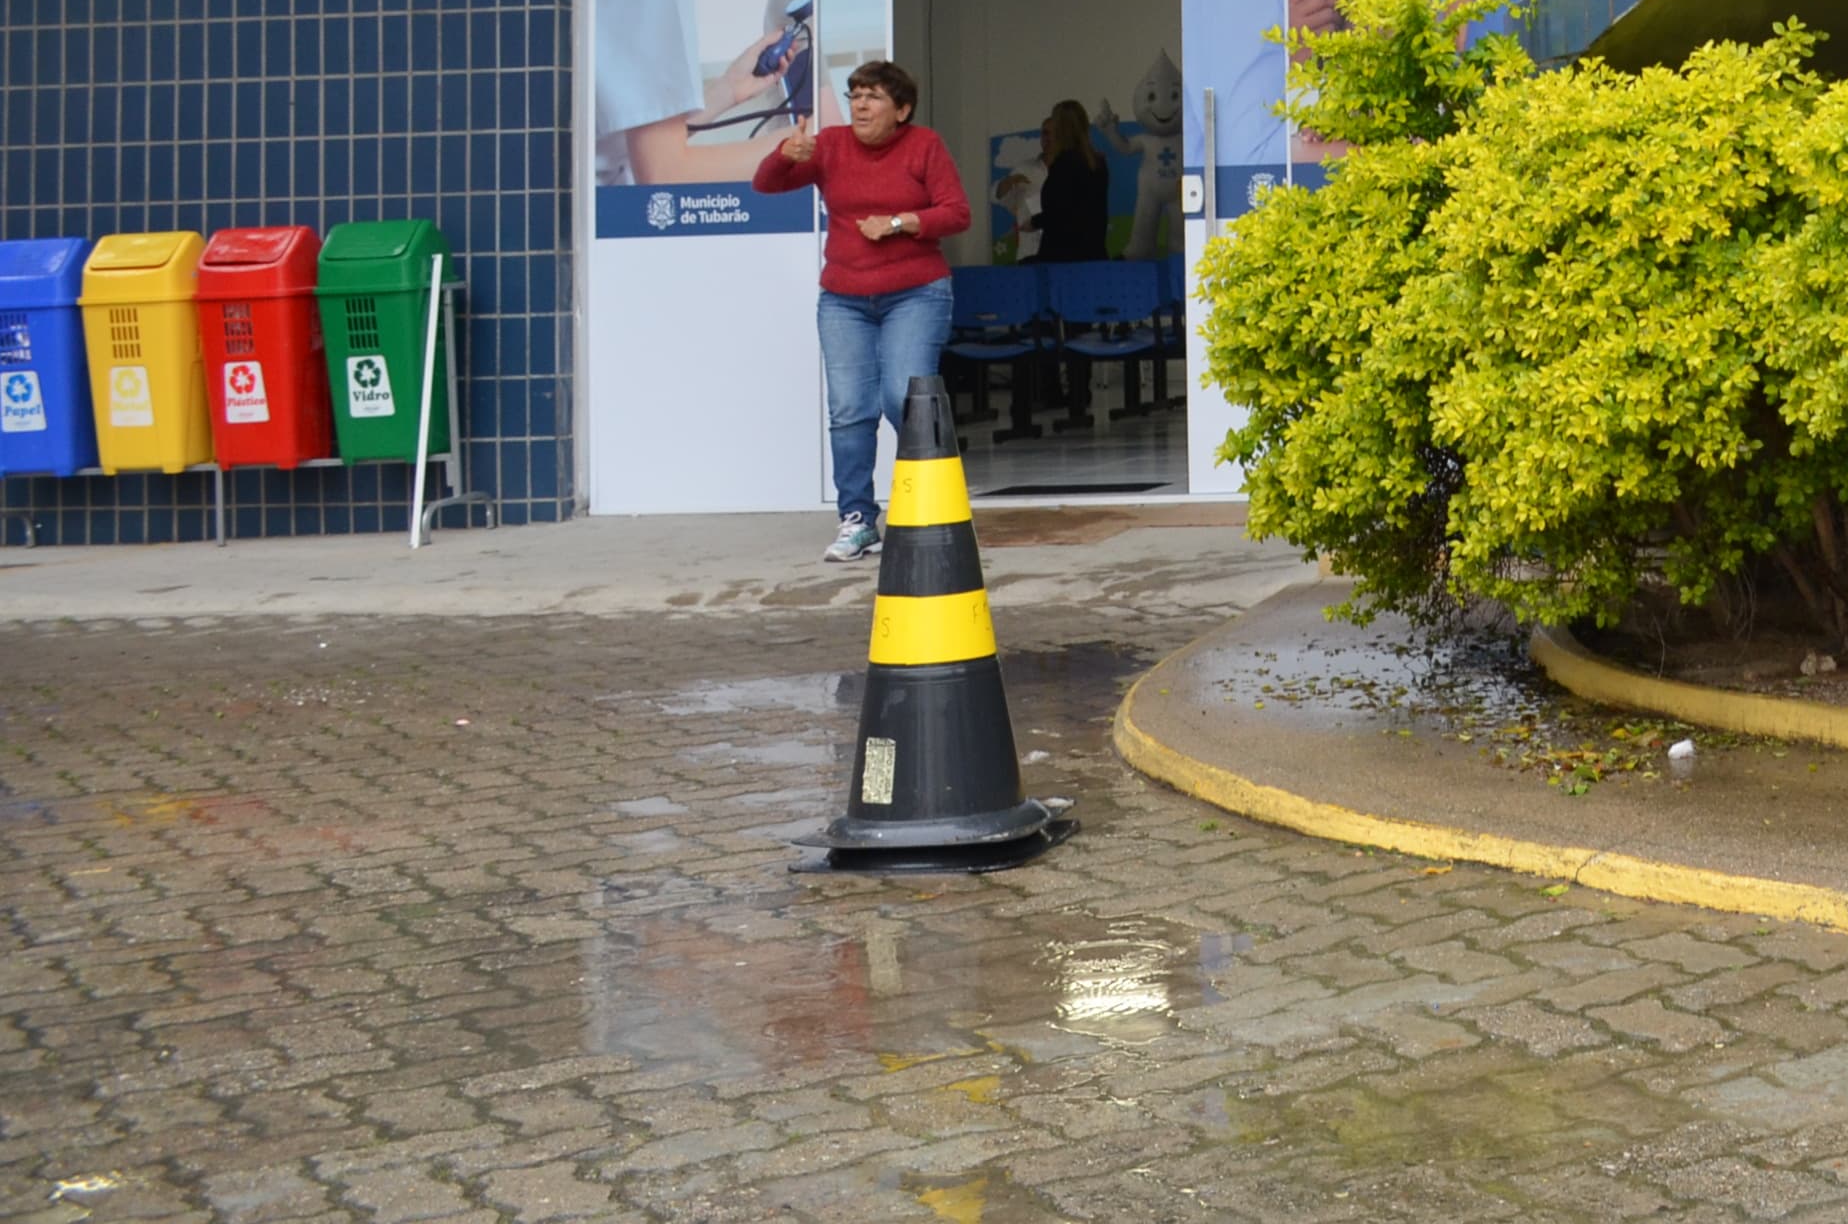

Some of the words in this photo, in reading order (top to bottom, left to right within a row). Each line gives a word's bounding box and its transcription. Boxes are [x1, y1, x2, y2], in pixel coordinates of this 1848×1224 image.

[680, 211, 697, 225] de
[699, 209, 750, 224] Tubarão
[352, 390, 390, 403] Vidro
[4, 404, 41, 419] Papel
